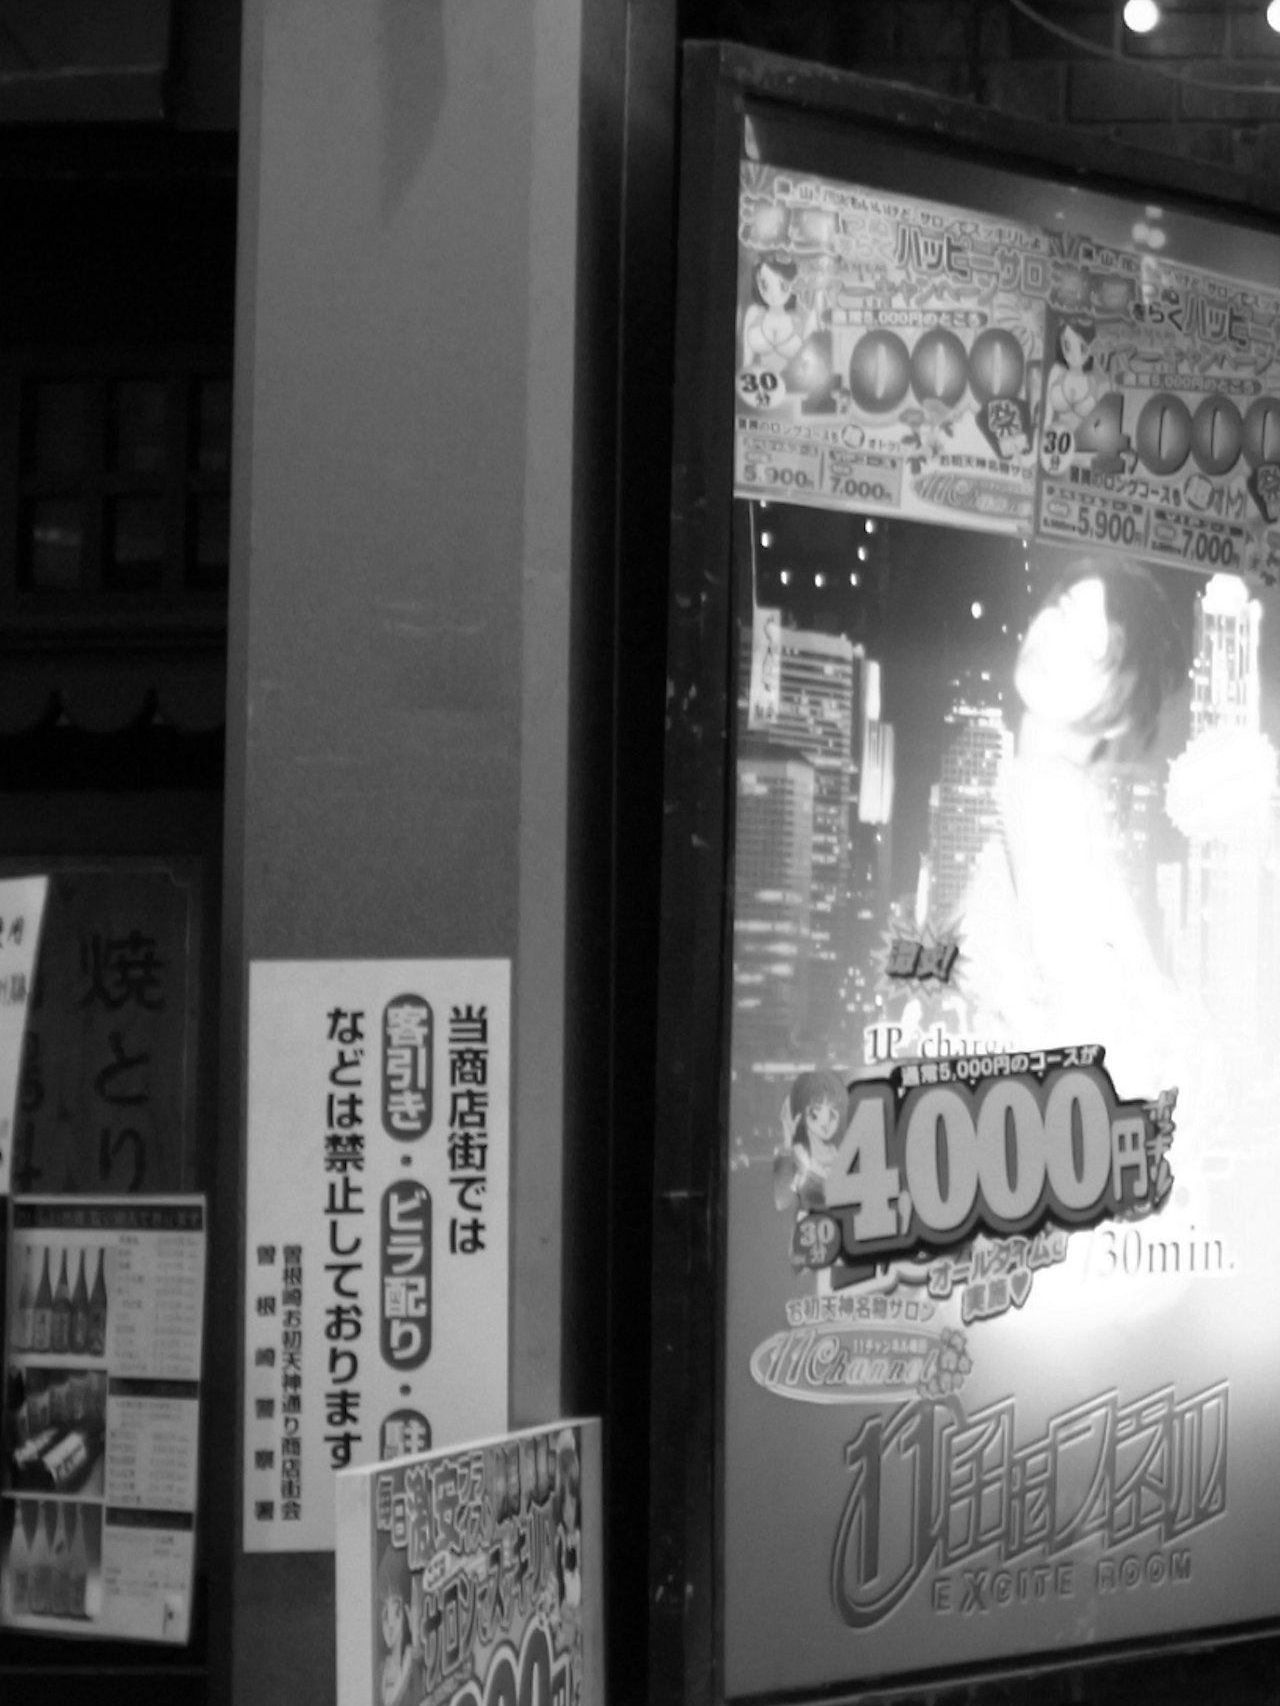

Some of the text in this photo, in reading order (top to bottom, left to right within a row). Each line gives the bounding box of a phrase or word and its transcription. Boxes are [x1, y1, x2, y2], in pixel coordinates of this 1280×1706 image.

[740, 373, 779, 394] 30
[1043, 430, 1072, 455] 30
[384, 999, 429, 1365] 客引き ビラ配り
[447, 1004, 490, 1257] 当商店街では
[825, 1071, 1148, 1243] 4,000円
[323, 1006, 366, 1471] などは禁止しております
[799, 1221, 836, 1248] 30
[933, 1549, 1194, 1614] EXCITE ROOM
